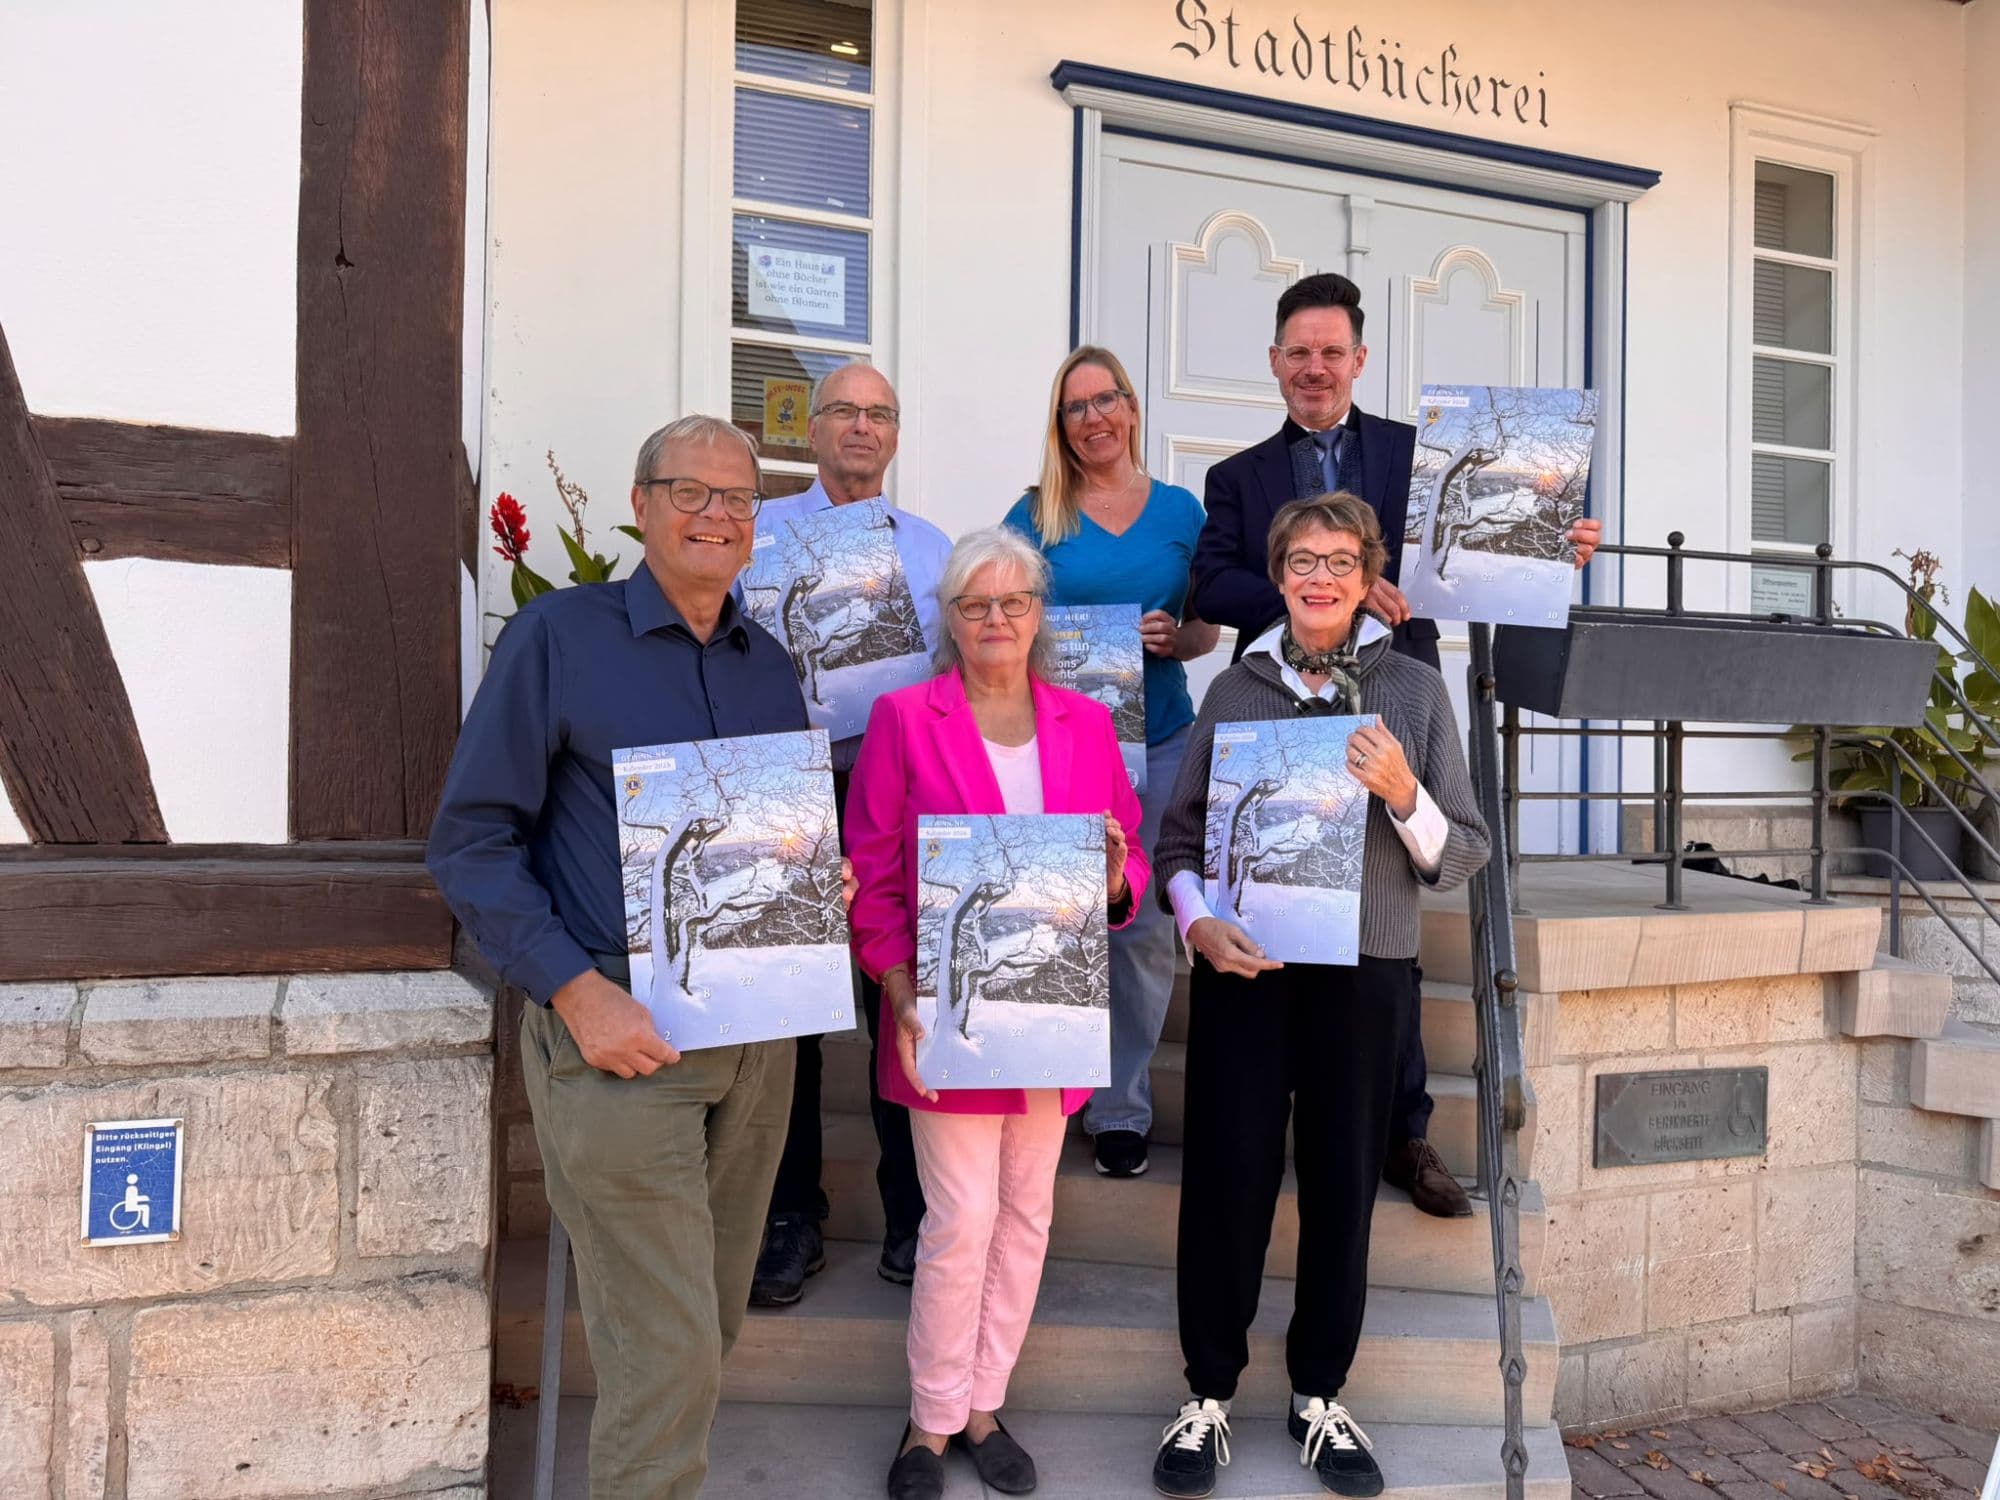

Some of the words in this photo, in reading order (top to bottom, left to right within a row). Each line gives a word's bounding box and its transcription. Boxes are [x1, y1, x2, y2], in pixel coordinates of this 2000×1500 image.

[1171, 0, 1549, 129] Stadtbücherei
[775, 257, 791, 267] Ein
[795, 258, 820, 270] Haus
[766, 268, 790, 280] ohne
[755, 279, 767, 289] ist
[770, 282, 786, 292] wie
[788, 284, 803, 294] ein
[806, 286, 839, 299] Garten
[764, 293, 790, 304] ohne
[792, 296, 830, 309] Blumen
[1460, 605, 1470, 614] 17
[1548, 611, 1558, 620] 10
[821, 910, 833, 920] 20
[1299, 945, 1307, 955] 6
[1338, 945, 1349, 957] 10
[825, 960, 839, 971] 23
[951, 959, 961, 969] 18
[740, 975, 754, 986] 22
[1086, 976, 1098, 986] 20
[703, 988, 711, 998] 8
[831, 1008, 842, 1020] 10
[780, 1016, 788, 1027] 6
[719, 1023, 731, 1034] 17
[664, 1031, 672, 1041] 2
[942, 1069, 949, 1079] 2
[990, 1068, 1001, 1079] 17
[1044, 1069, 1052, 1079] 6
[1089, 1068, 1100, 1078] 10
[1650, 1080, 1712, 1097] EINGANG
[96, 1132, 119, 1142] Bitte
[120, 1130, 176, 1141] rückseitigen
[96, 1144, 132, 1154] Eingang
[134, 1141, 172, 1151] (Klingel)
[95, 1155, 129, 1165] nutzen.
